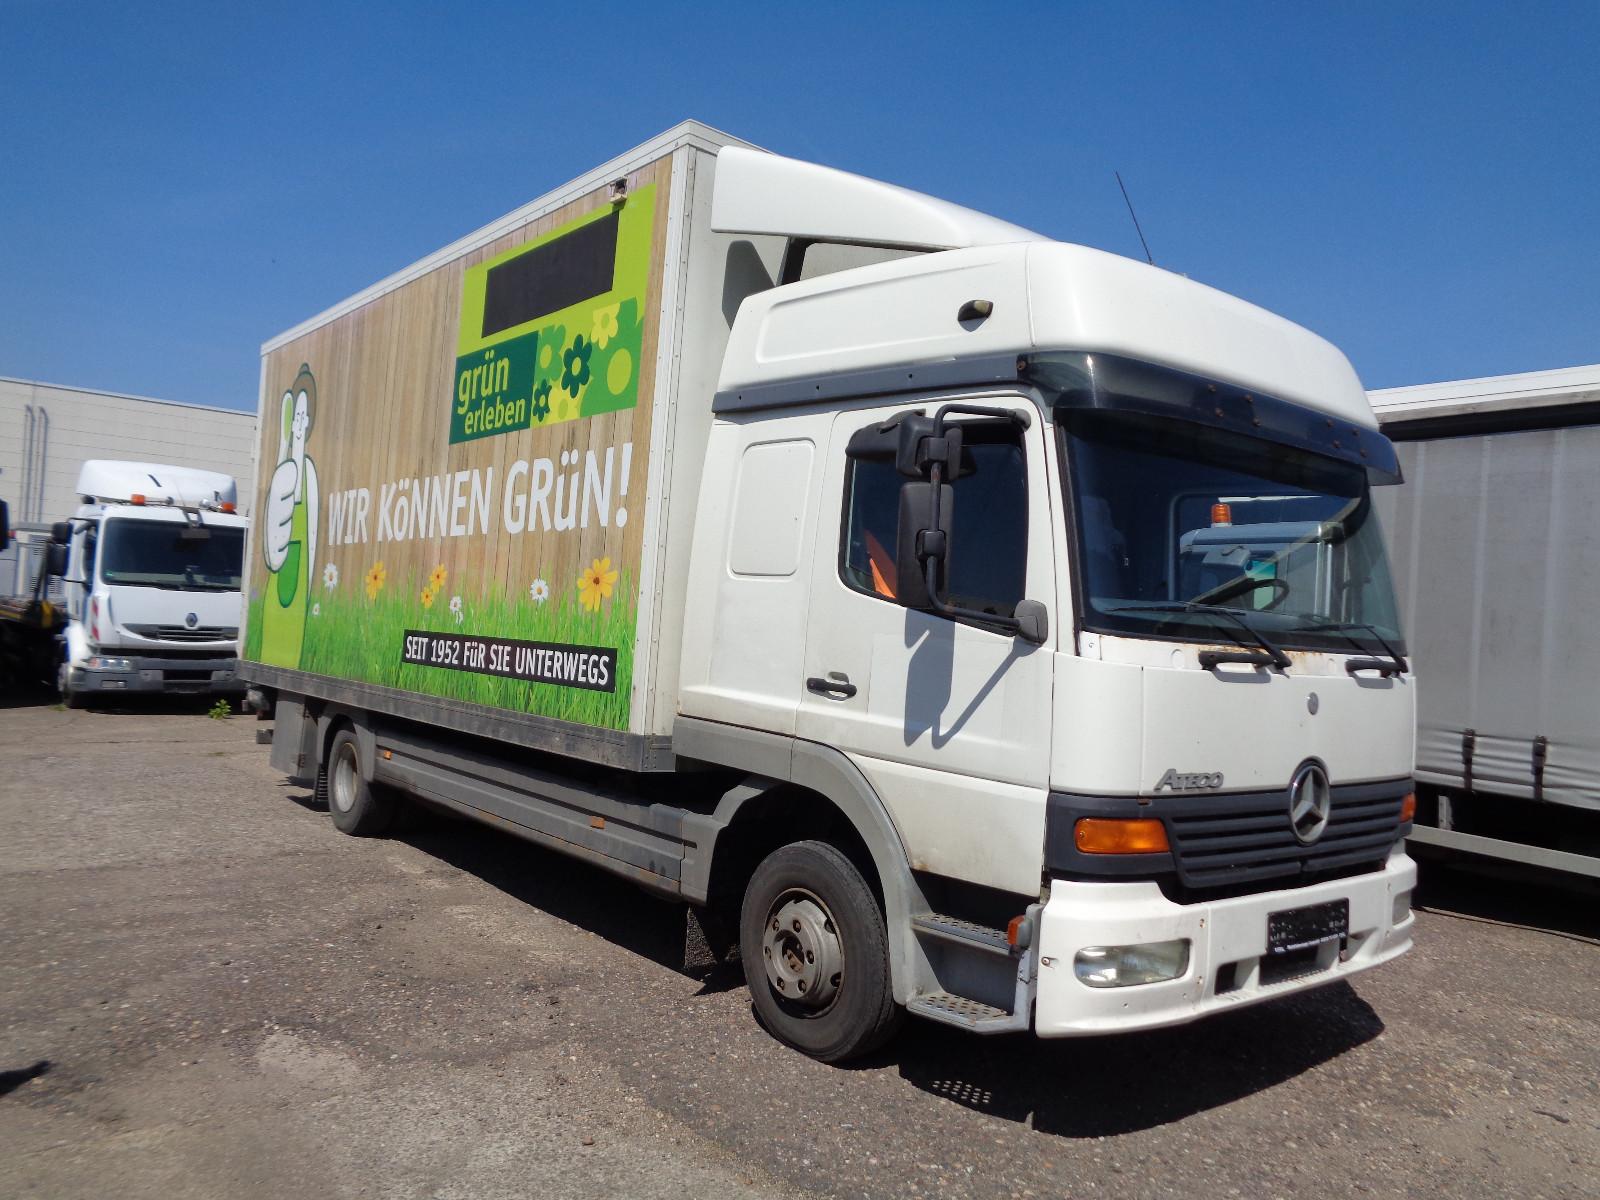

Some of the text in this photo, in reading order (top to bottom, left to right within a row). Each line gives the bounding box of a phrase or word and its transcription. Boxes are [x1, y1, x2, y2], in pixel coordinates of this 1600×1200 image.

[458, 350, 510, 415] grün
[464, 396, 526, 434] erleben
[328, 487, 370, 546] WIR
[405, 635, 429, 660] SEIT
[430, 639, 460, 665] 1952
[488, 644, 511, 673] SIE
[514, 647, 610, 686] UNTERWEGS
